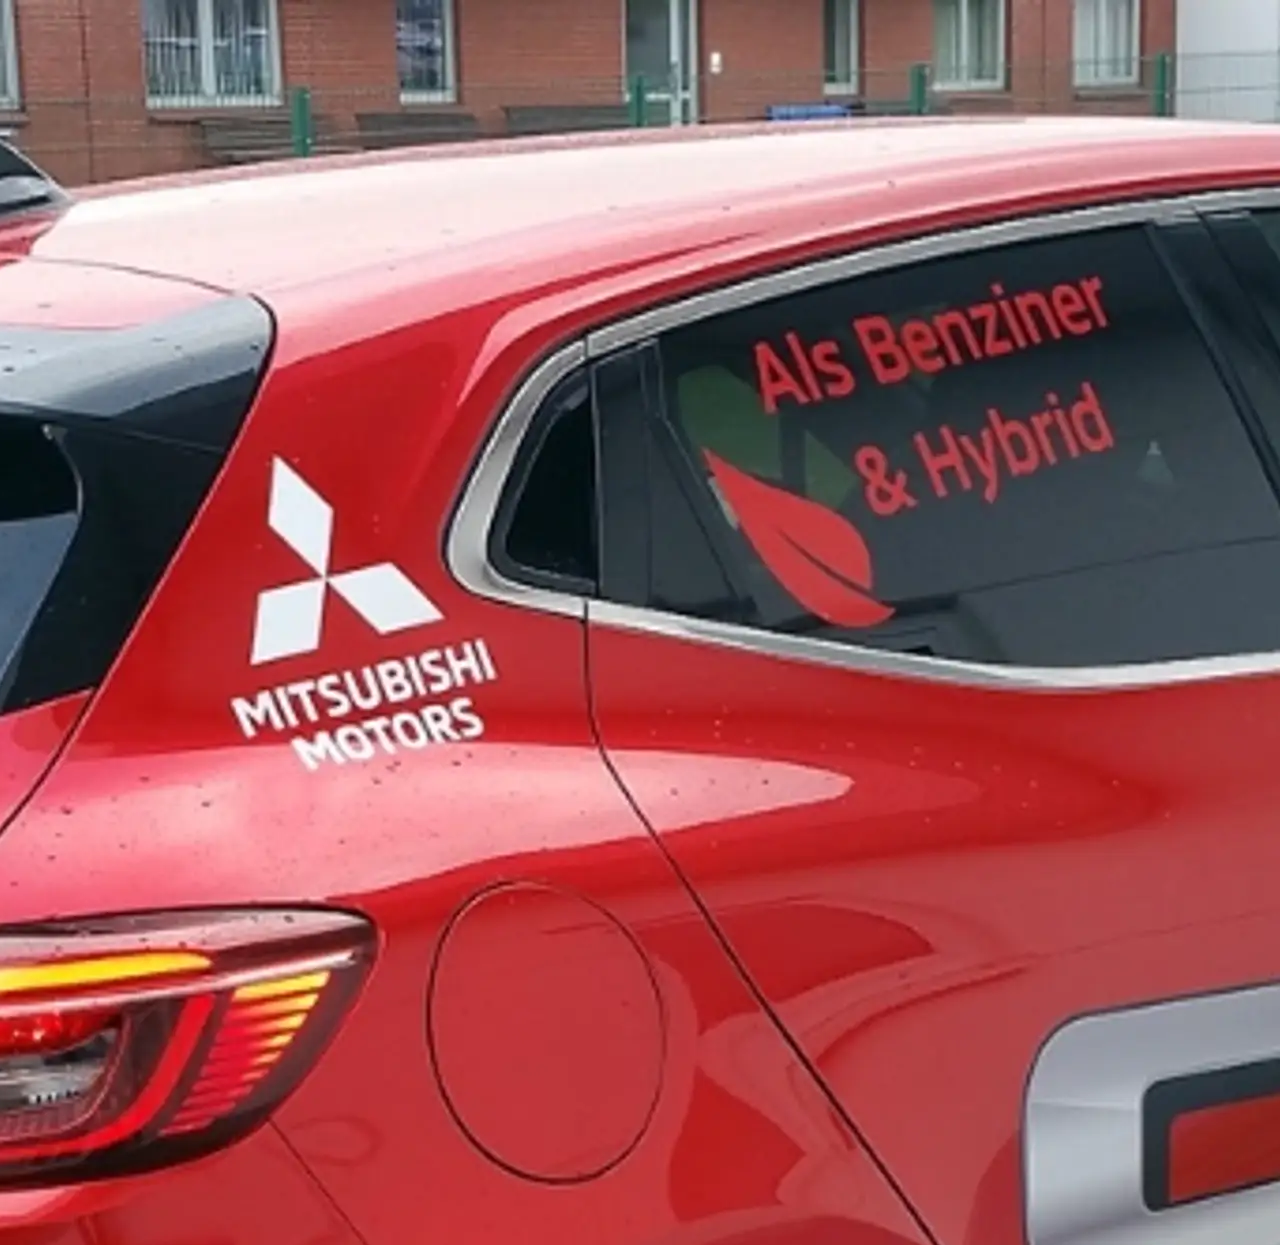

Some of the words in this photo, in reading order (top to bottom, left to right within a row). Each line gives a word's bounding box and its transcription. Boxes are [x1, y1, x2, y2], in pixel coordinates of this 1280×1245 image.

[753, 331, 856, 414] Als
[853, 275, 1109, 386] Benziner
[854, 444, 918, 516] &
[913, 381, 1115, 503] Hybrid
[230, 637, 498, 738] MITSUBISHI
[290, 697, 485, 773] MOTORS
